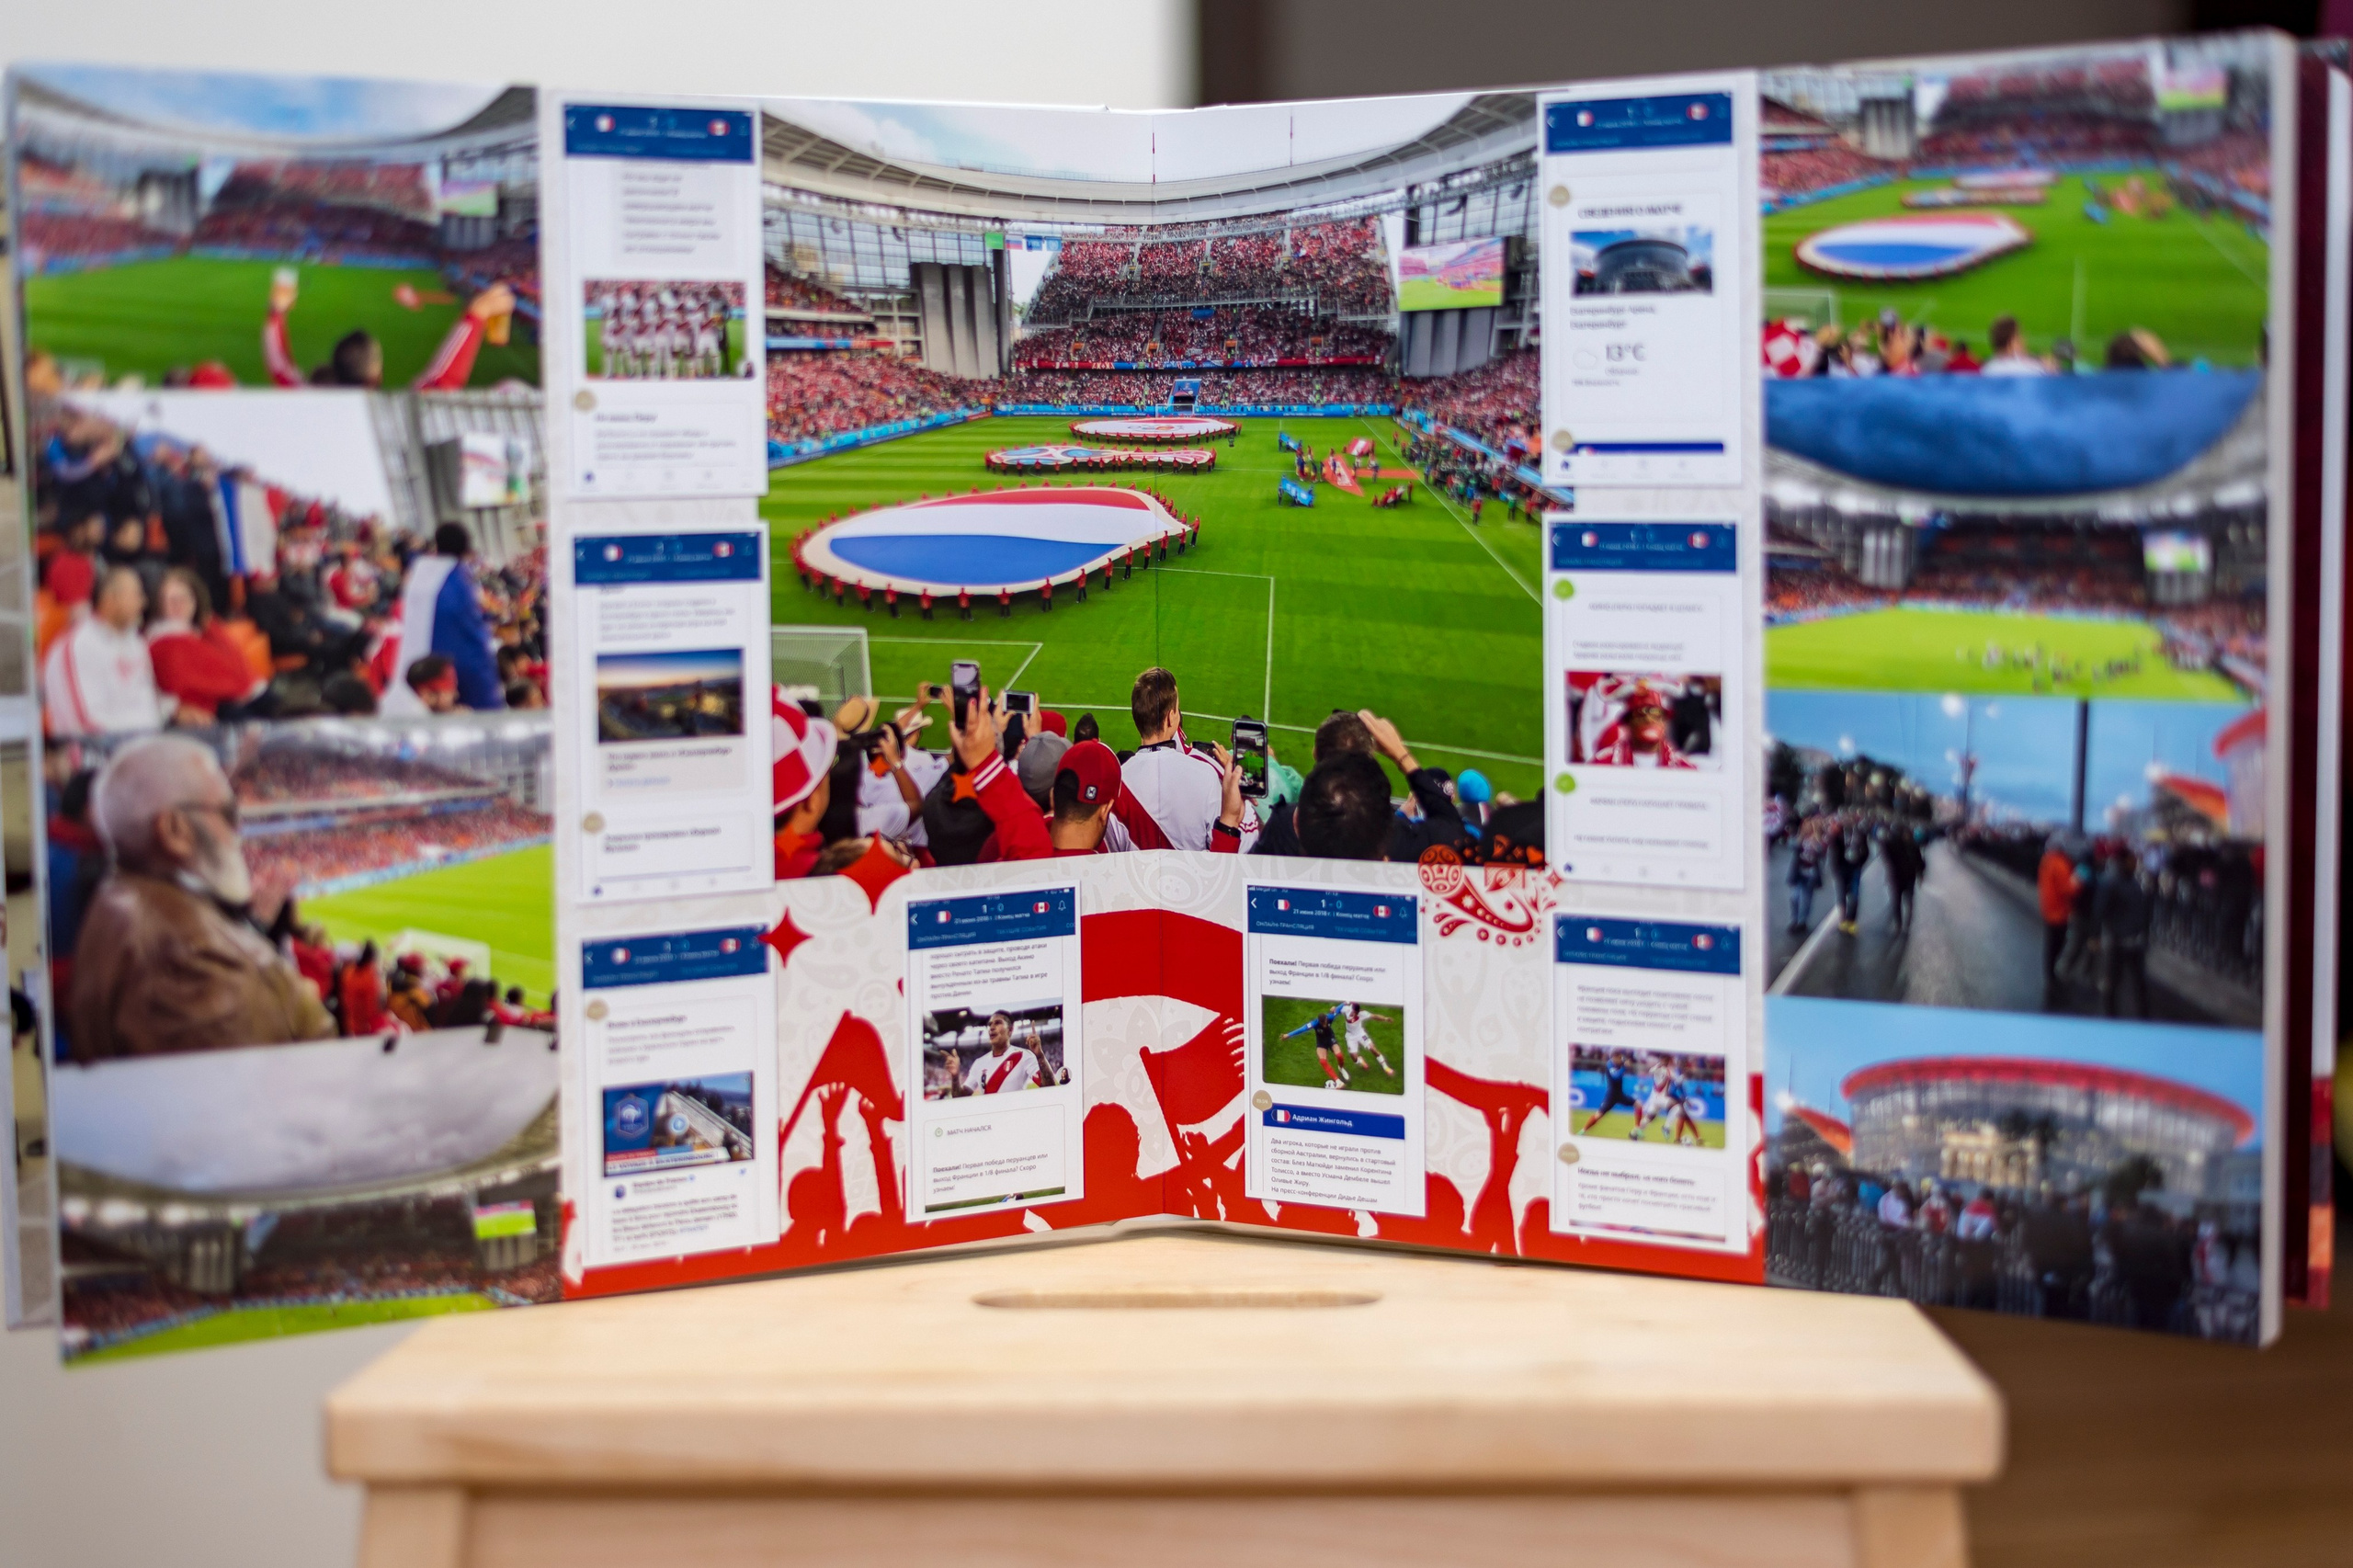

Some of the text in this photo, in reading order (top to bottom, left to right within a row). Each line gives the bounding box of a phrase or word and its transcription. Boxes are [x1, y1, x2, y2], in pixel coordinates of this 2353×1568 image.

[982, 904, 987, 914] 1
[997, 903, 1004, 912] 0
[1321, 899, 1326, 908] 1
[1336, 900, 1342, 909] 0
[1292, 1114, 1353, 1127] Адриан Жингольд
[995, 1166, 1018, 1176] финала?
[1344, 1174, 1369, 1182] Дембеле
